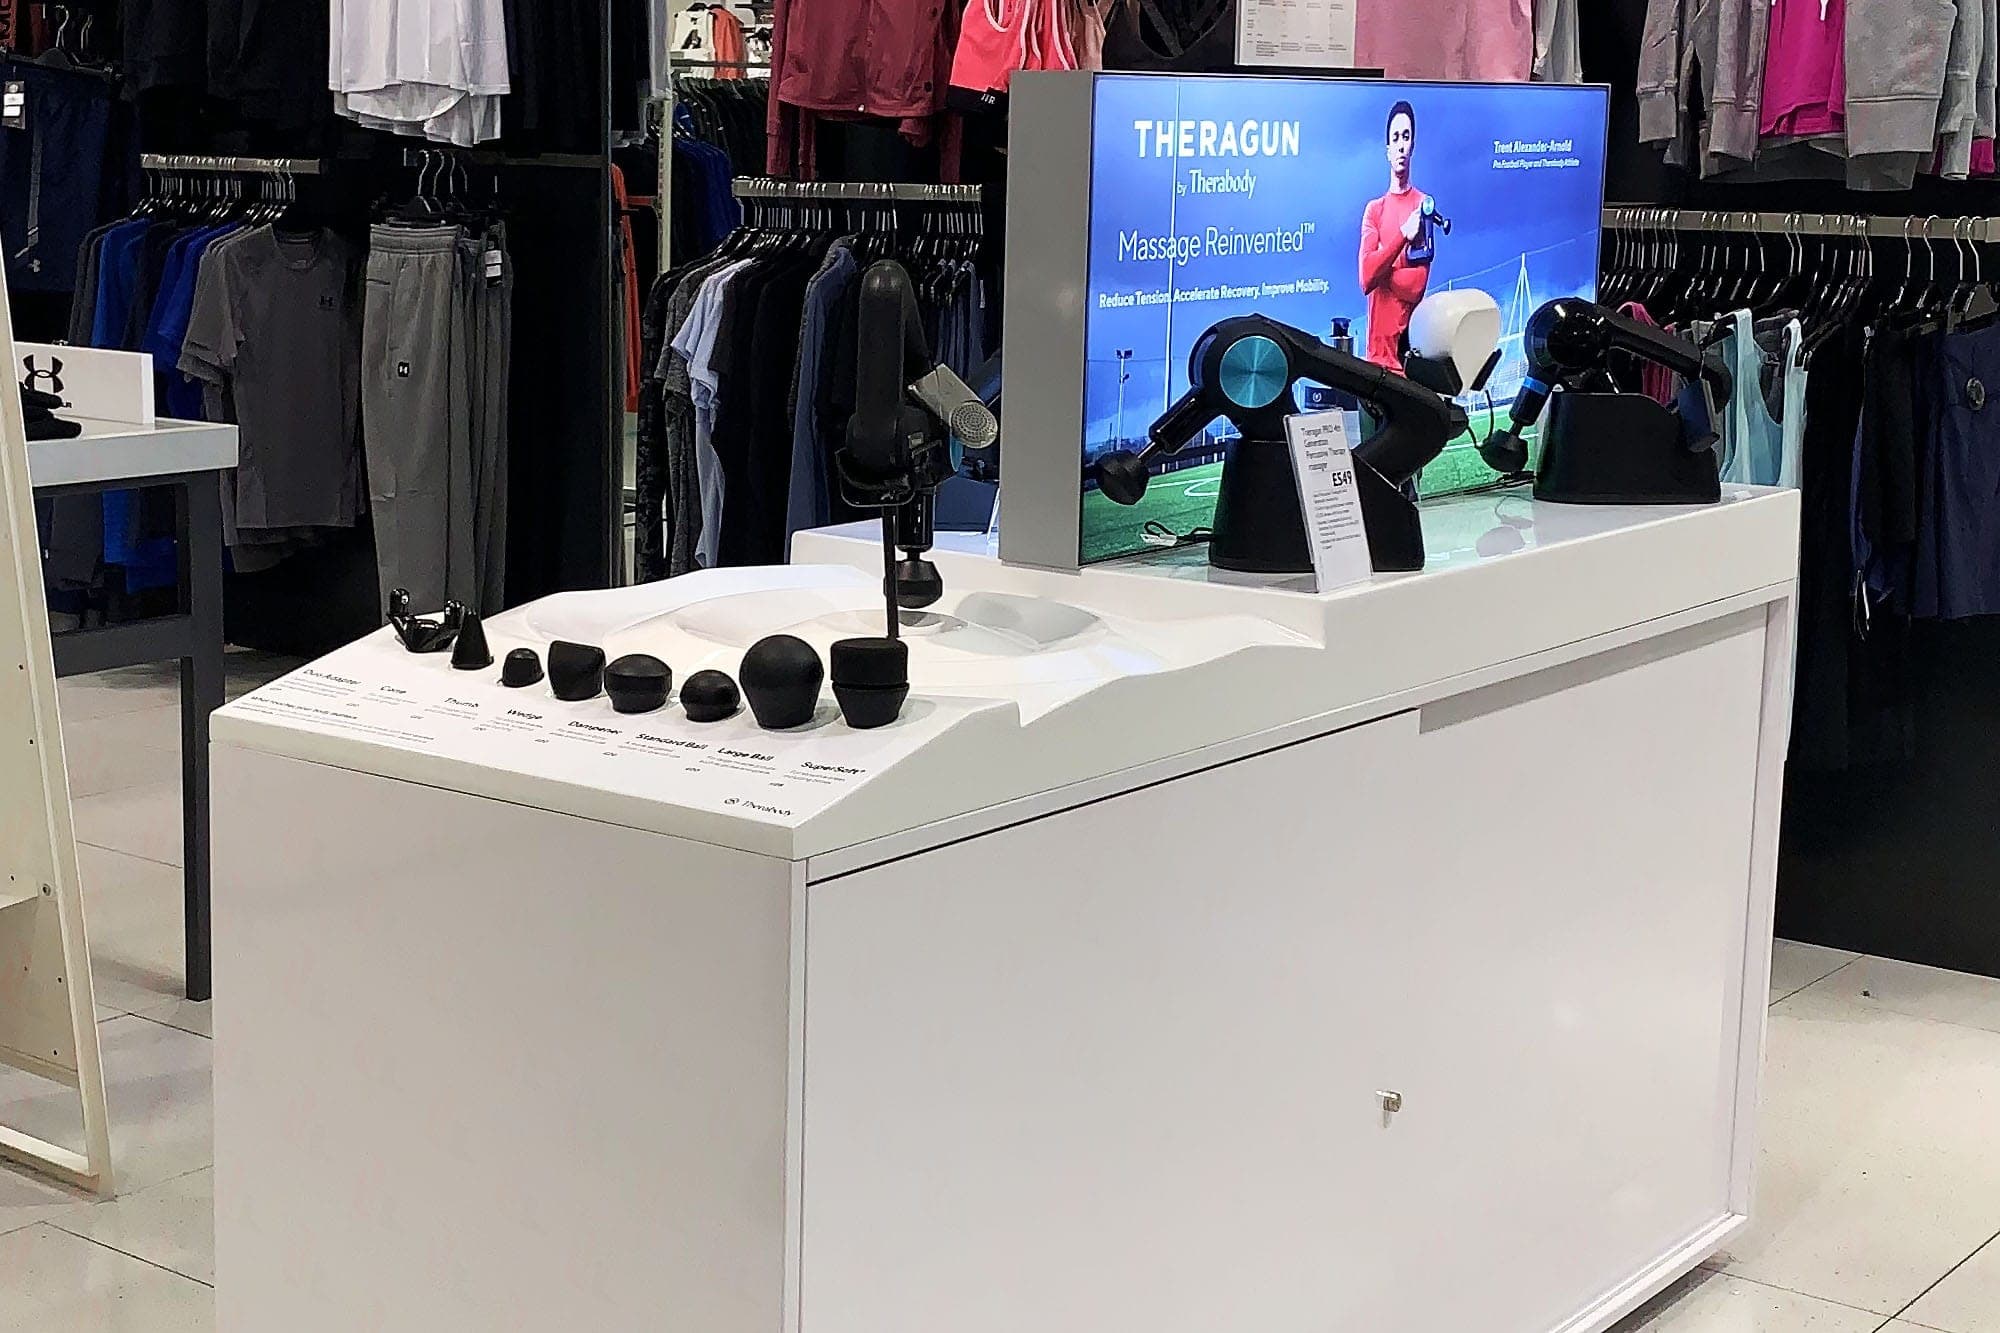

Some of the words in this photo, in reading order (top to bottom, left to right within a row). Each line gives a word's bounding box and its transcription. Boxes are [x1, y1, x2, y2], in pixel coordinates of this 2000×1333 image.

[1134, 120, 1300, 158] THERAGUN
[1493, 140, 1513, 154] Trent
[1513, 139, 1573, 153] Alexander-Arnold
[1177, 181, 1188, 197] by
[1189, 168, 1257, 200] Therabody
[1118, 230, 1201, 267] Massage
[1099, 292, 1135, 308] Reduce
[1173, 287, 1219, 303] Accelerate
[1220, 284, 1261, 300] Recovery.
[1262, 281, 1295, 298] Improve
[1295, 278, 1330, 295] Mobility.
[567, 720, 623, 735] Dampener
[635, 733, 686, 747] Standard
[684, 740, 709, 750] Ball
[717, 747, 751, 758] Large
[750, 752, 775, 762] Ball
